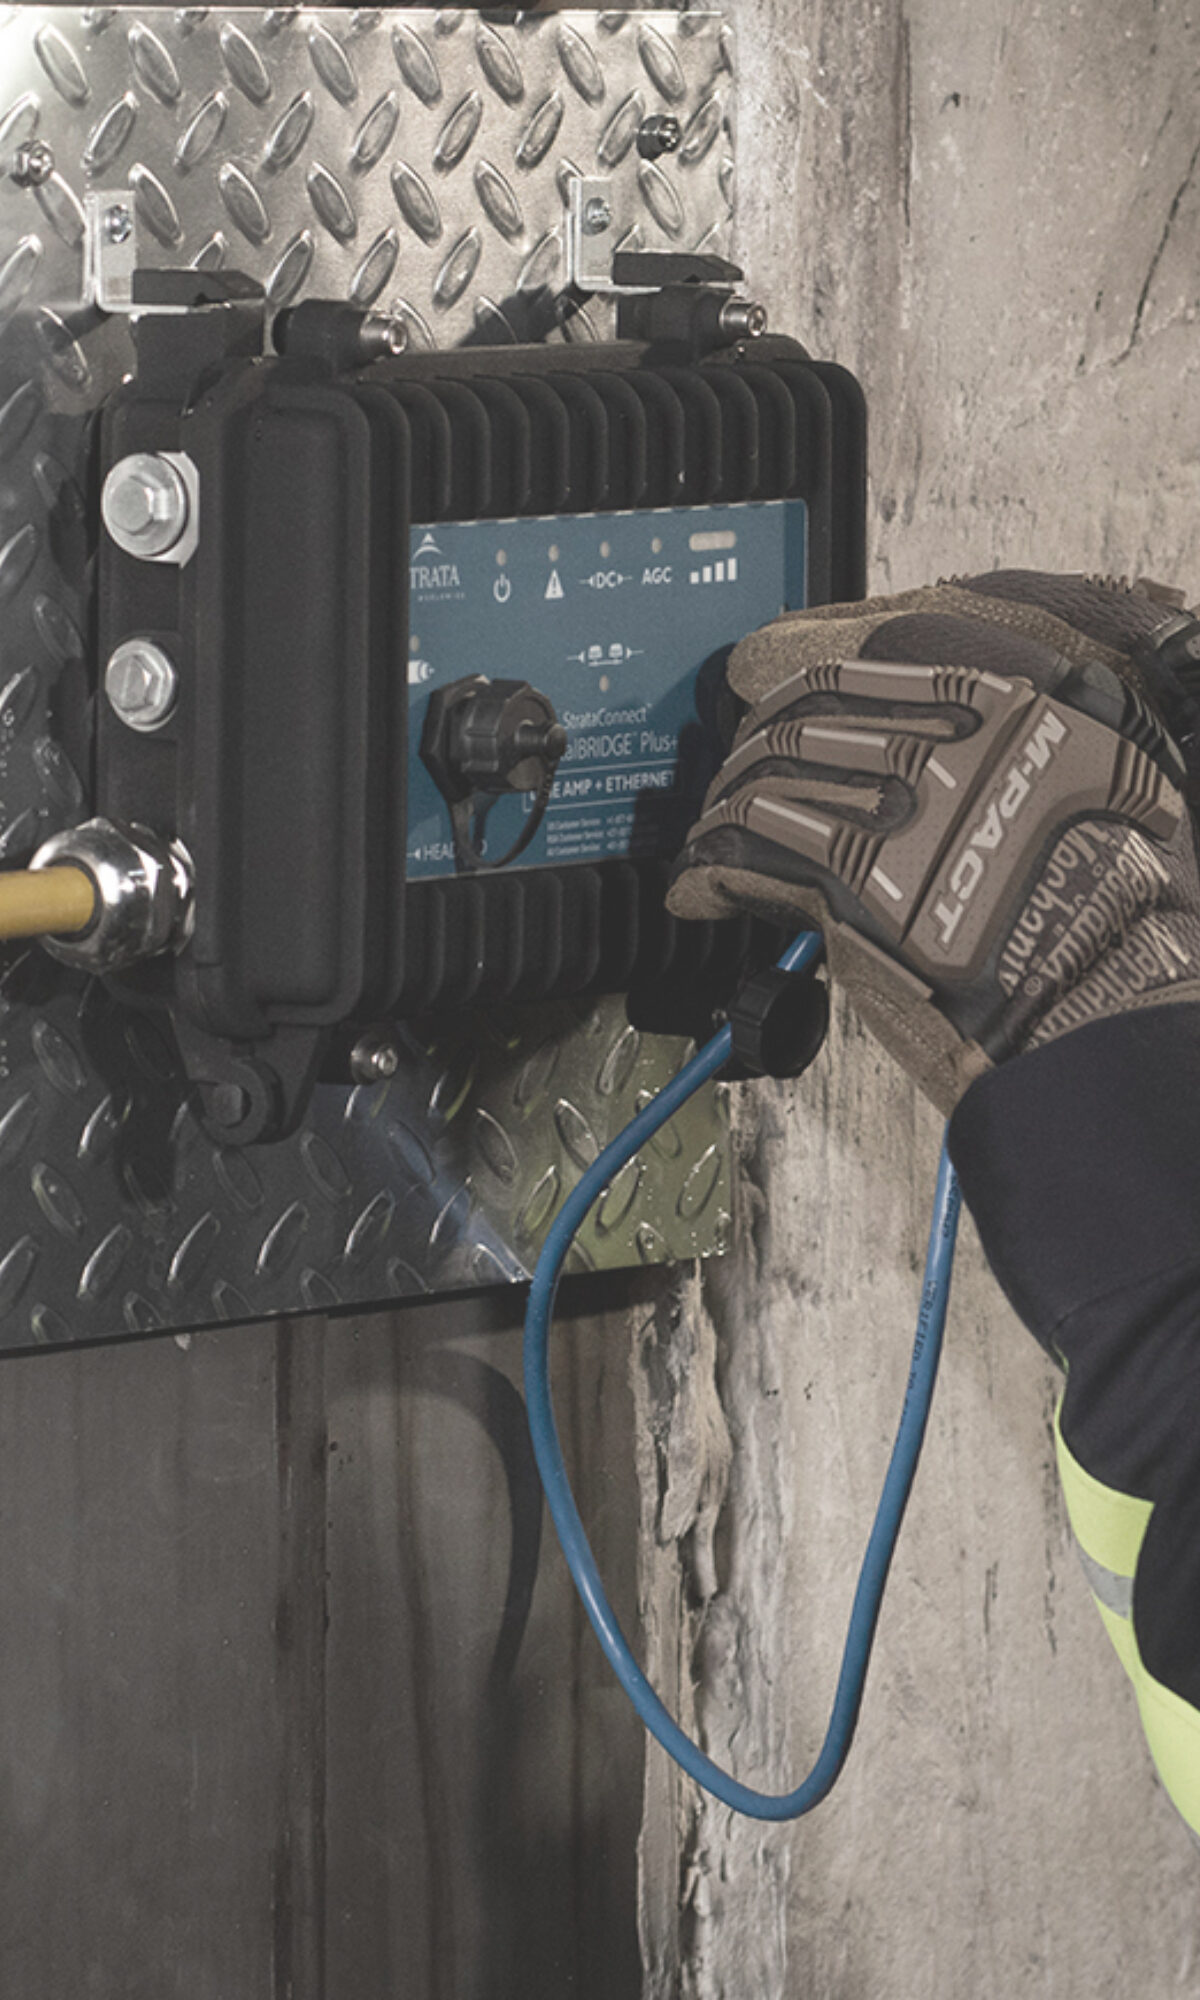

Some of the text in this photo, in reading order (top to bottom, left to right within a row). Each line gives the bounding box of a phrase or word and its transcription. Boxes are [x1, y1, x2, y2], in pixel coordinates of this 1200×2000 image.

[409, 564, 461, 590] TRATA
[595, 571, 617, 589] DC
[642, 567, 673, 585] AGC
[640, 730, 679, 754] Plus+
[562, 778, 593, 799] AMP
[605, 770, 676, 794] ETHERNET
[934, 711, 1067, 943] M-PACT
